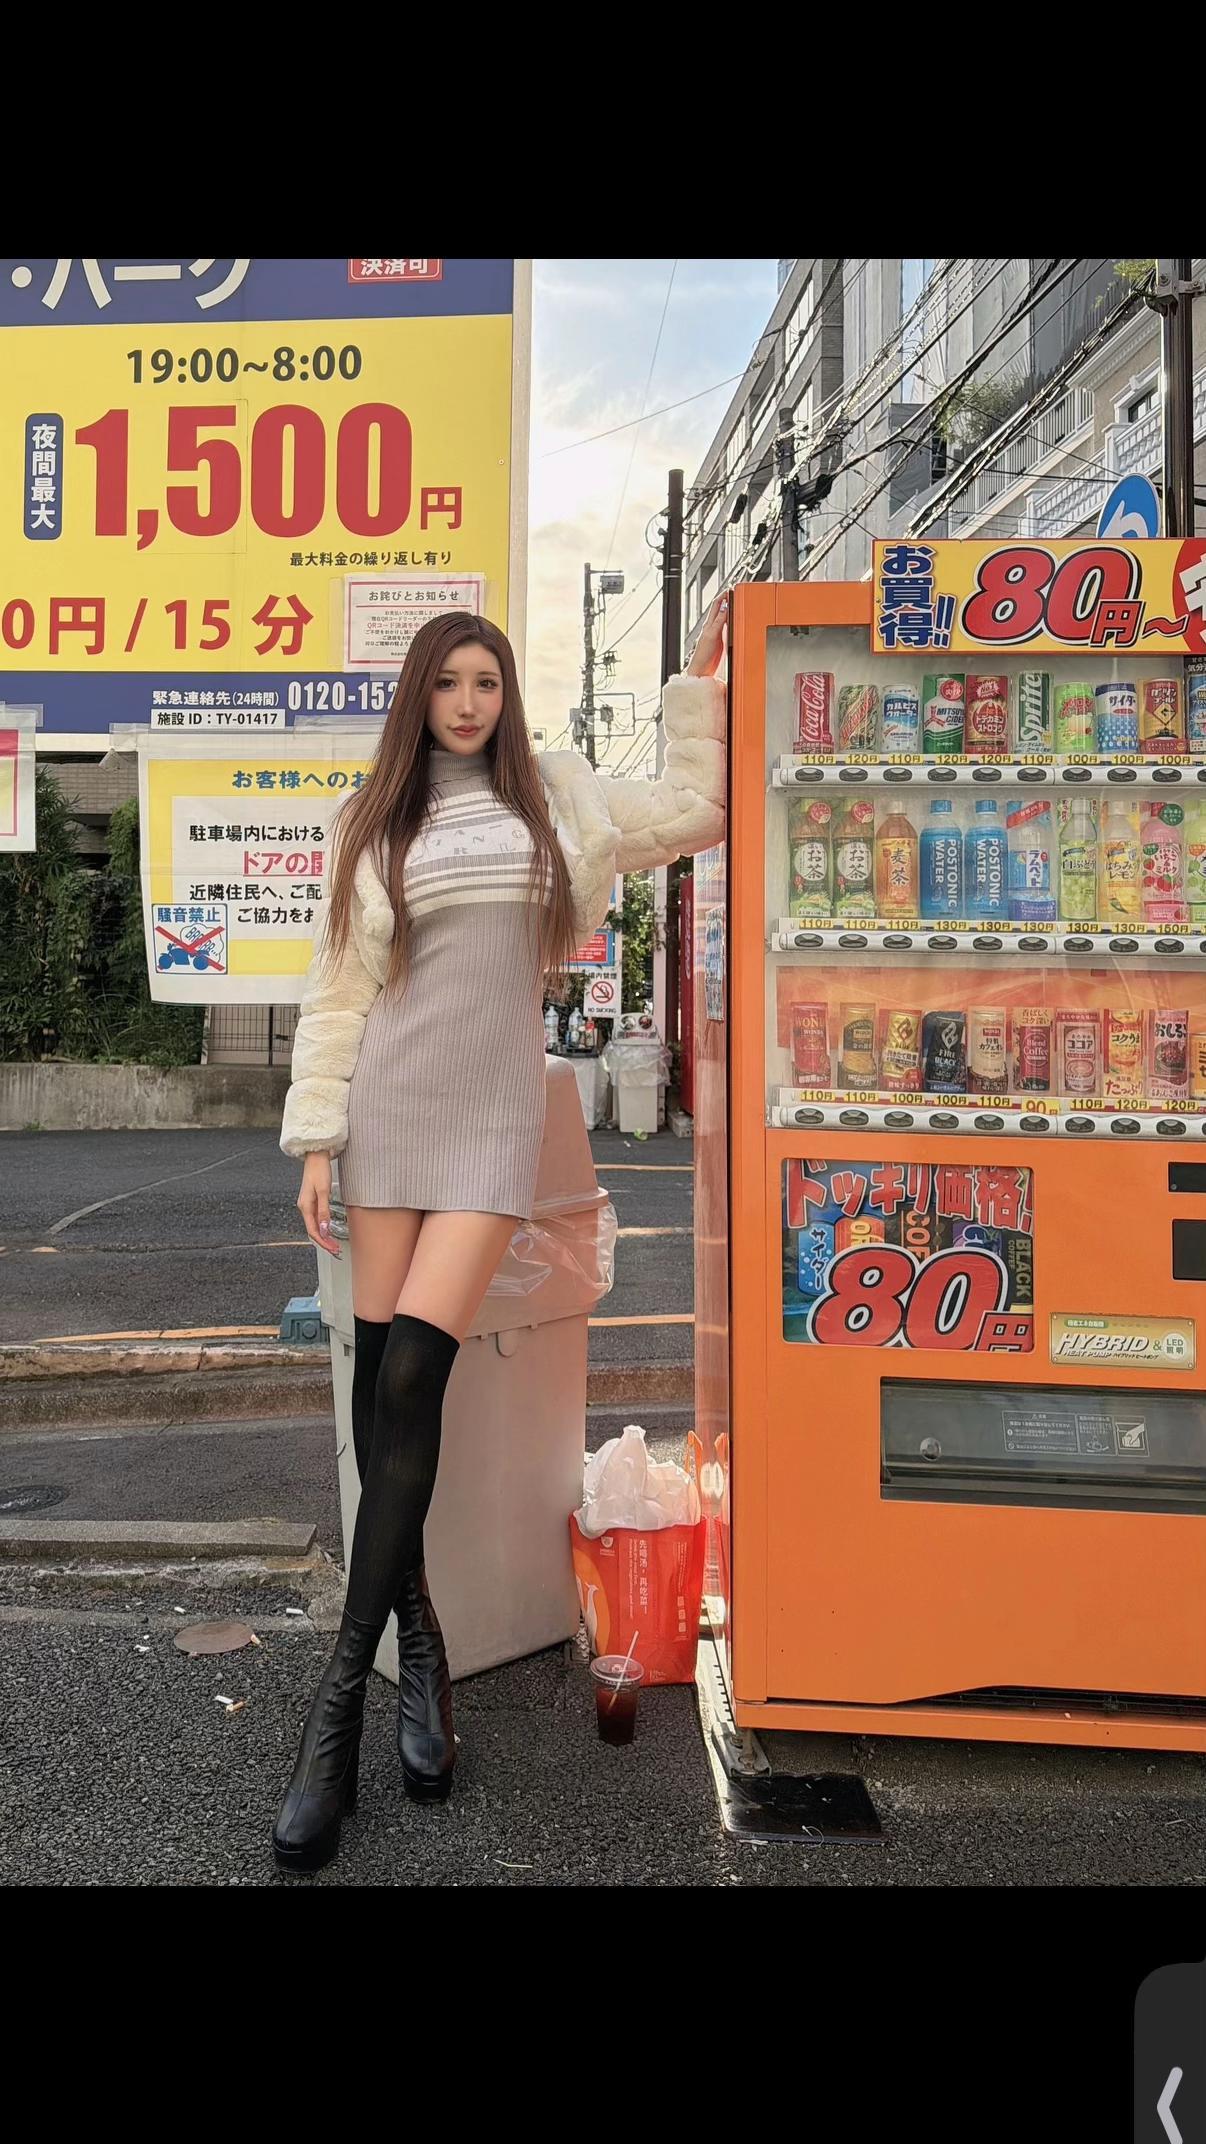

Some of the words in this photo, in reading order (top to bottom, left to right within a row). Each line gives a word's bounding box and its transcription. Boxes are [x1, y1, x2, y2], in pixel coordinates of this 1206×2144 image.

[30, 423, 57, 529] 夜間最大
[75, 402, 463, 551] 1,500円
[290, 550, 452, 567] 最大料金の繰り返し有り
[368, 590, 460, 602] お詫びとお知らせ
[804, 755, 834, 764] 110円
[848, 755, 878, 764] 120円
[891, 755, 921, 764] 110円
[937, 755, 968, 764] 120円
[982, 755, 1011, 764] 120円
[1023, 755, 1053, 764] 110円
[1067, 755, 1098, 764] 100円
[1114, 755, 1144, 764] 100円
[1160, 755, 1190, 765] 100円
[188, 825, 325, 842] 駐車場内における
[934, 838, 944, 884] WATER
[976, 838, 987, 884] WATER
[890, 847, 910, 886] 麦茶
[946, 838, 957, 908] POSTONIC
[988, 838, 1000, 907] POSTONIC
[157, 906, 222, 923] 騒音禁止
[802, 919, 832, 928] 110円
[846, 920, 876, 929] 110円
[888, 920, 919, 929] 110円
[936, 921, 967, 930] 130円
[980, 921, 1010, 931] 130円
[1023, 923, 1054, 932] 130円
[1068, 923, 1099, 932] 130円
[1115, 923, 1145, 933] 130円
[802, 1091, 833, 1100] 110円
[846, 1092, 876, 1101] 110円
[892, 1093, 923, 1103] 100円
[936, 1095, 967, 1105] 100円
[979, 1096, 1010, 1106] 110円
[1072, 1100, 1103, 1109] 110円
[1117, 1101, 1147, 1110] 120円
[1165, 1101, 1196, 1111] 120円
[1016, 1238, 1032, 1298] BLACK
[1056, 1332, 1150, 1355] HYBRID
[1166, 1338, 1184, 1346] LED
